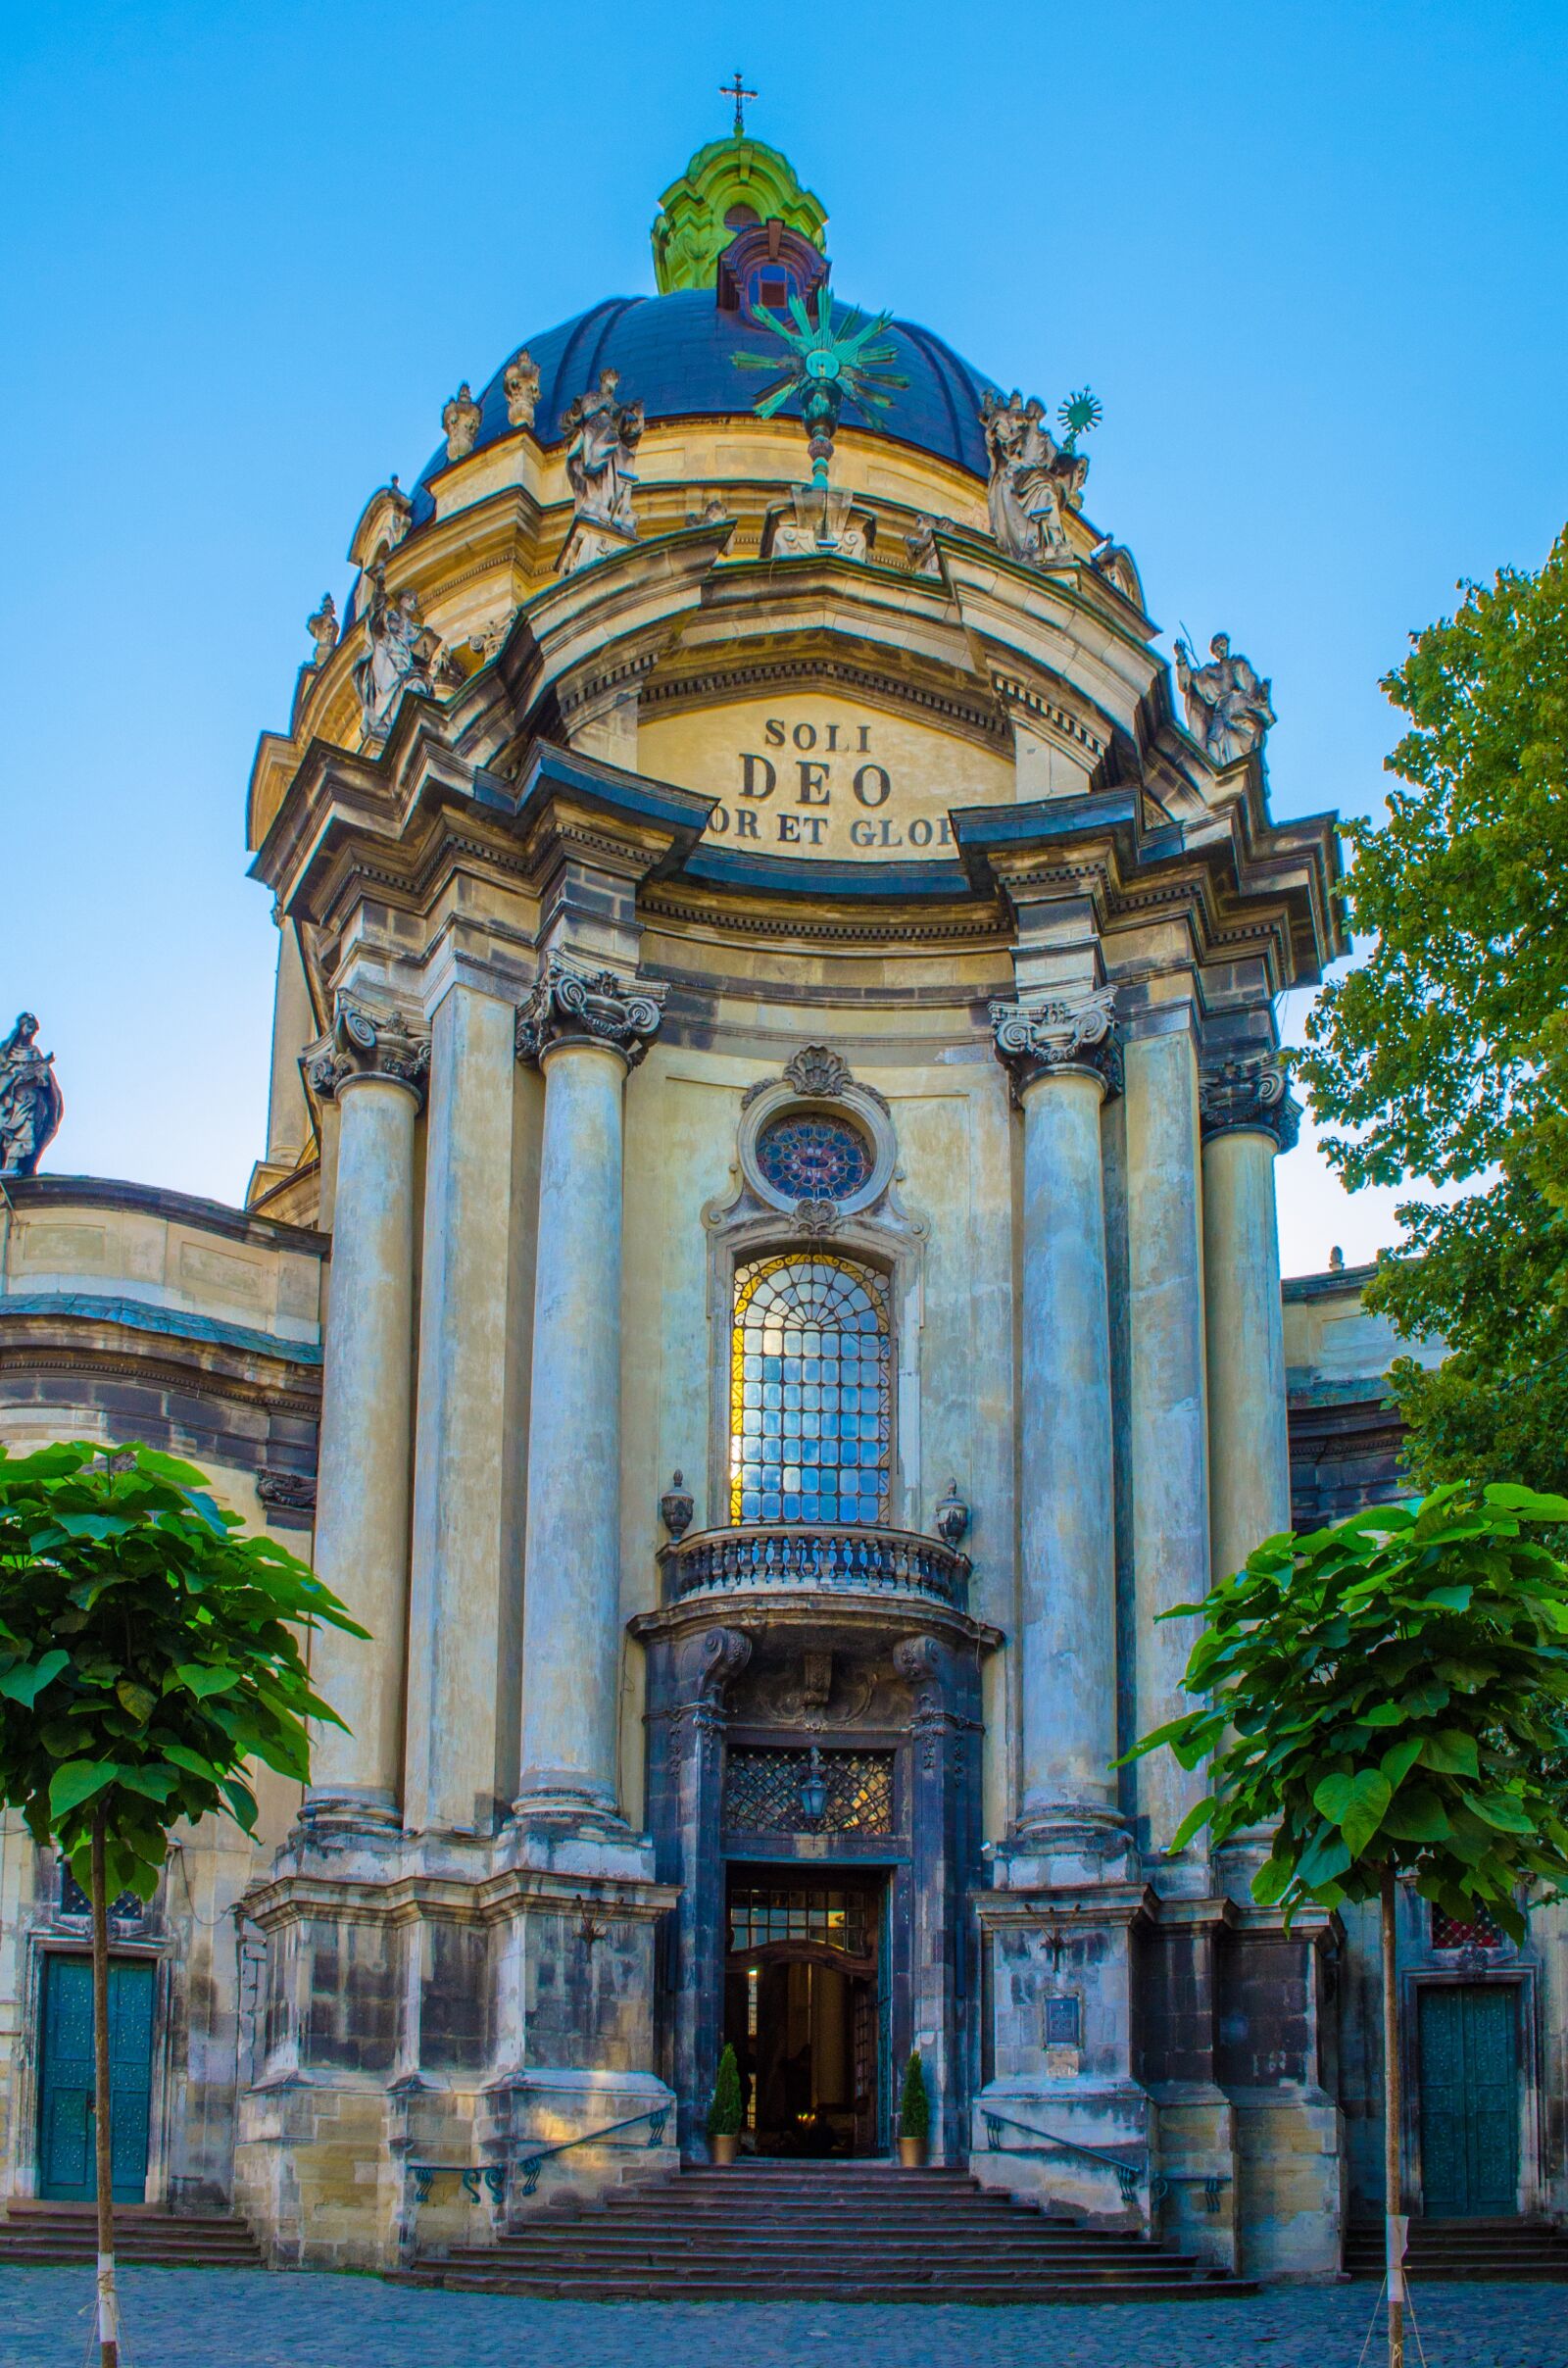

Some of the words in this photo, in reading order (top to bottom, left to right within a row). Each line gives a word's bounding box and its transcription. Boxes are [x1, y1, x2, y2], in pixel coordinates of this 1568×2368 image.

[764, 718, 871, 753] SOLI
[738, 753, 891, 807] DEO
[776, 814, 829, 845] ET
